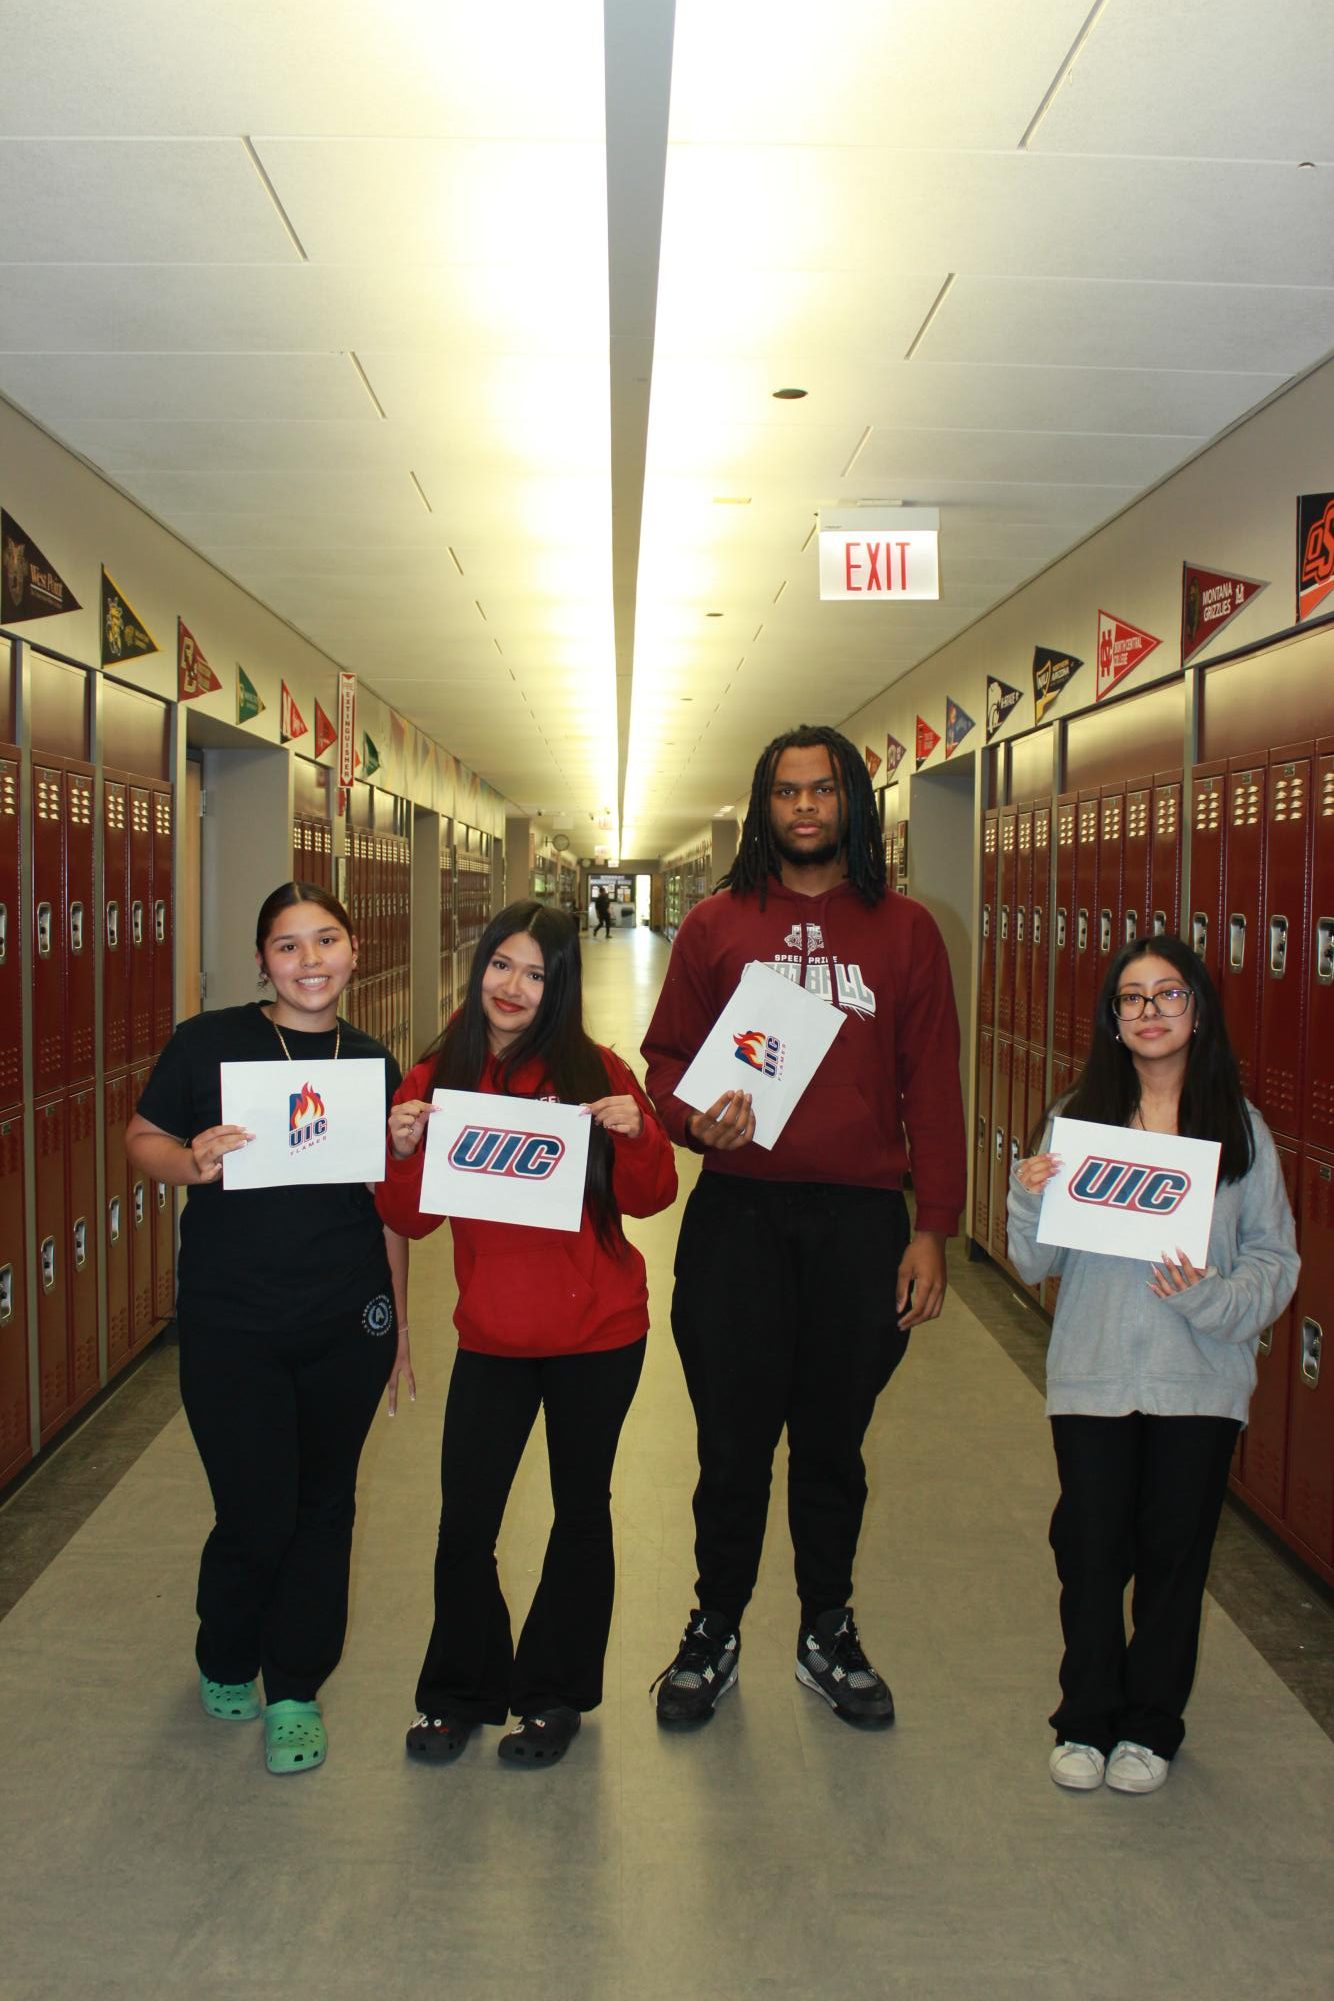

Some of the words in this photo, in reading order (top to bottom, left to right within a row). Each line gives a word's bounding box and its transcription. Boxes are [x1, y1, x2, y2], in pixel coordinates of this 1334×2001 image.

[845, 542, 911, 592] EXIT
[1202, 581, 1233, 607] MONTANA
[1203, 598, 1231, 622] GRIZZLIES
[763, 1036, 780, 1078] UIC
[289, 1118, 328, 1148] UIC
[450, 1127, 563, 1178] UIC
[1070, 1158, 1189, 1213] UIC
